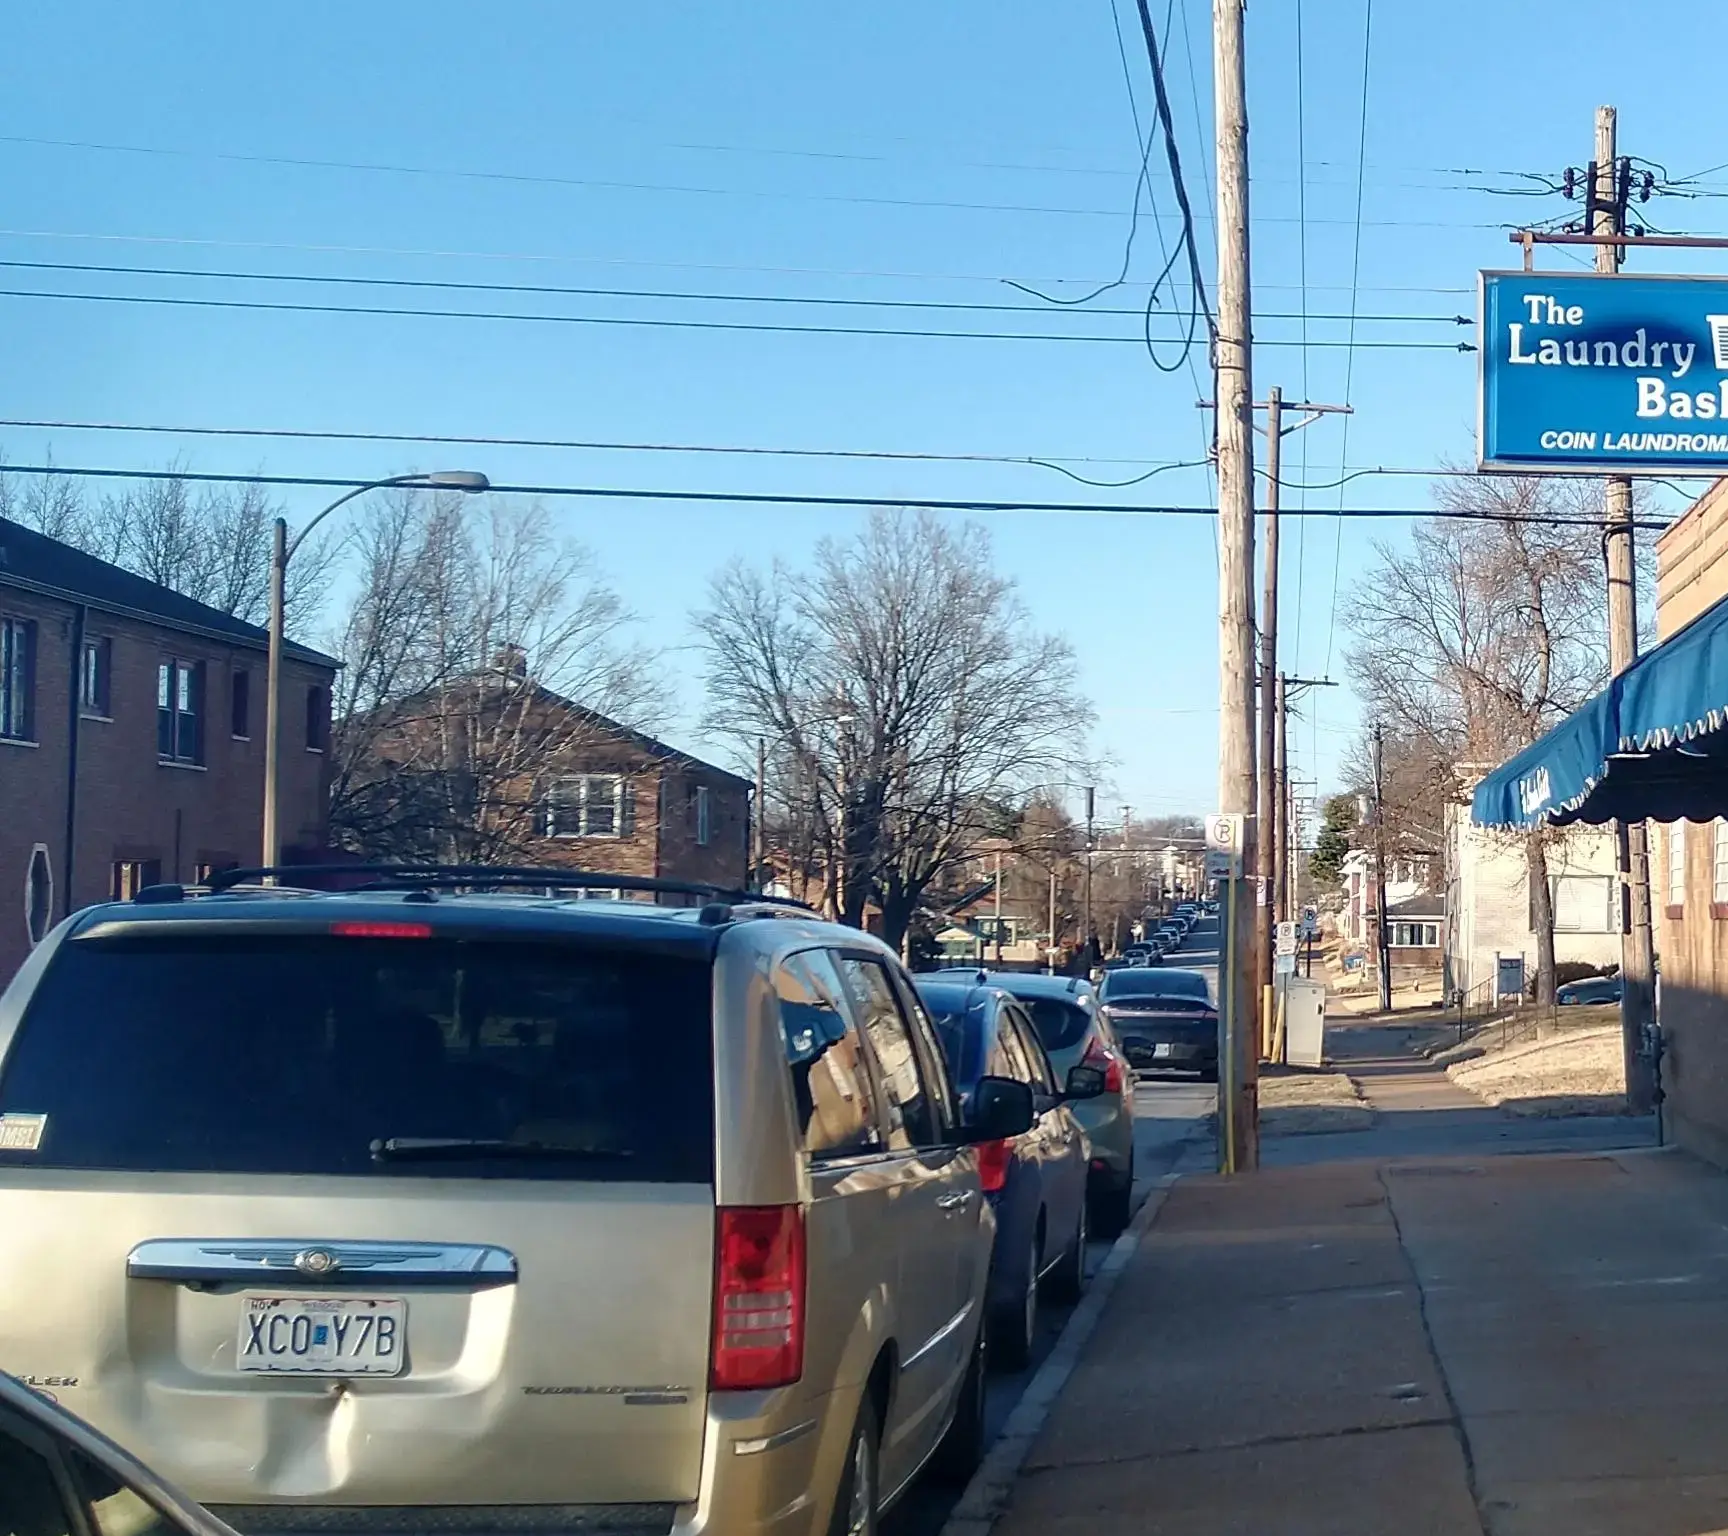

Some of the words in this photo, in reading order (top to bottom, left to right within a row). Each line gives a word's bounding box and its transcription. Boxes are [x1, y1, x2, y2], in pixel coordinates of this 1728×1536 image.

[1523, 294, 1584, 325] The
[1508, 323, 1696, 378] Laundry
[1540, 430, 1596, 450] COIN
[332, 1314, 397, 1357] Y7B
